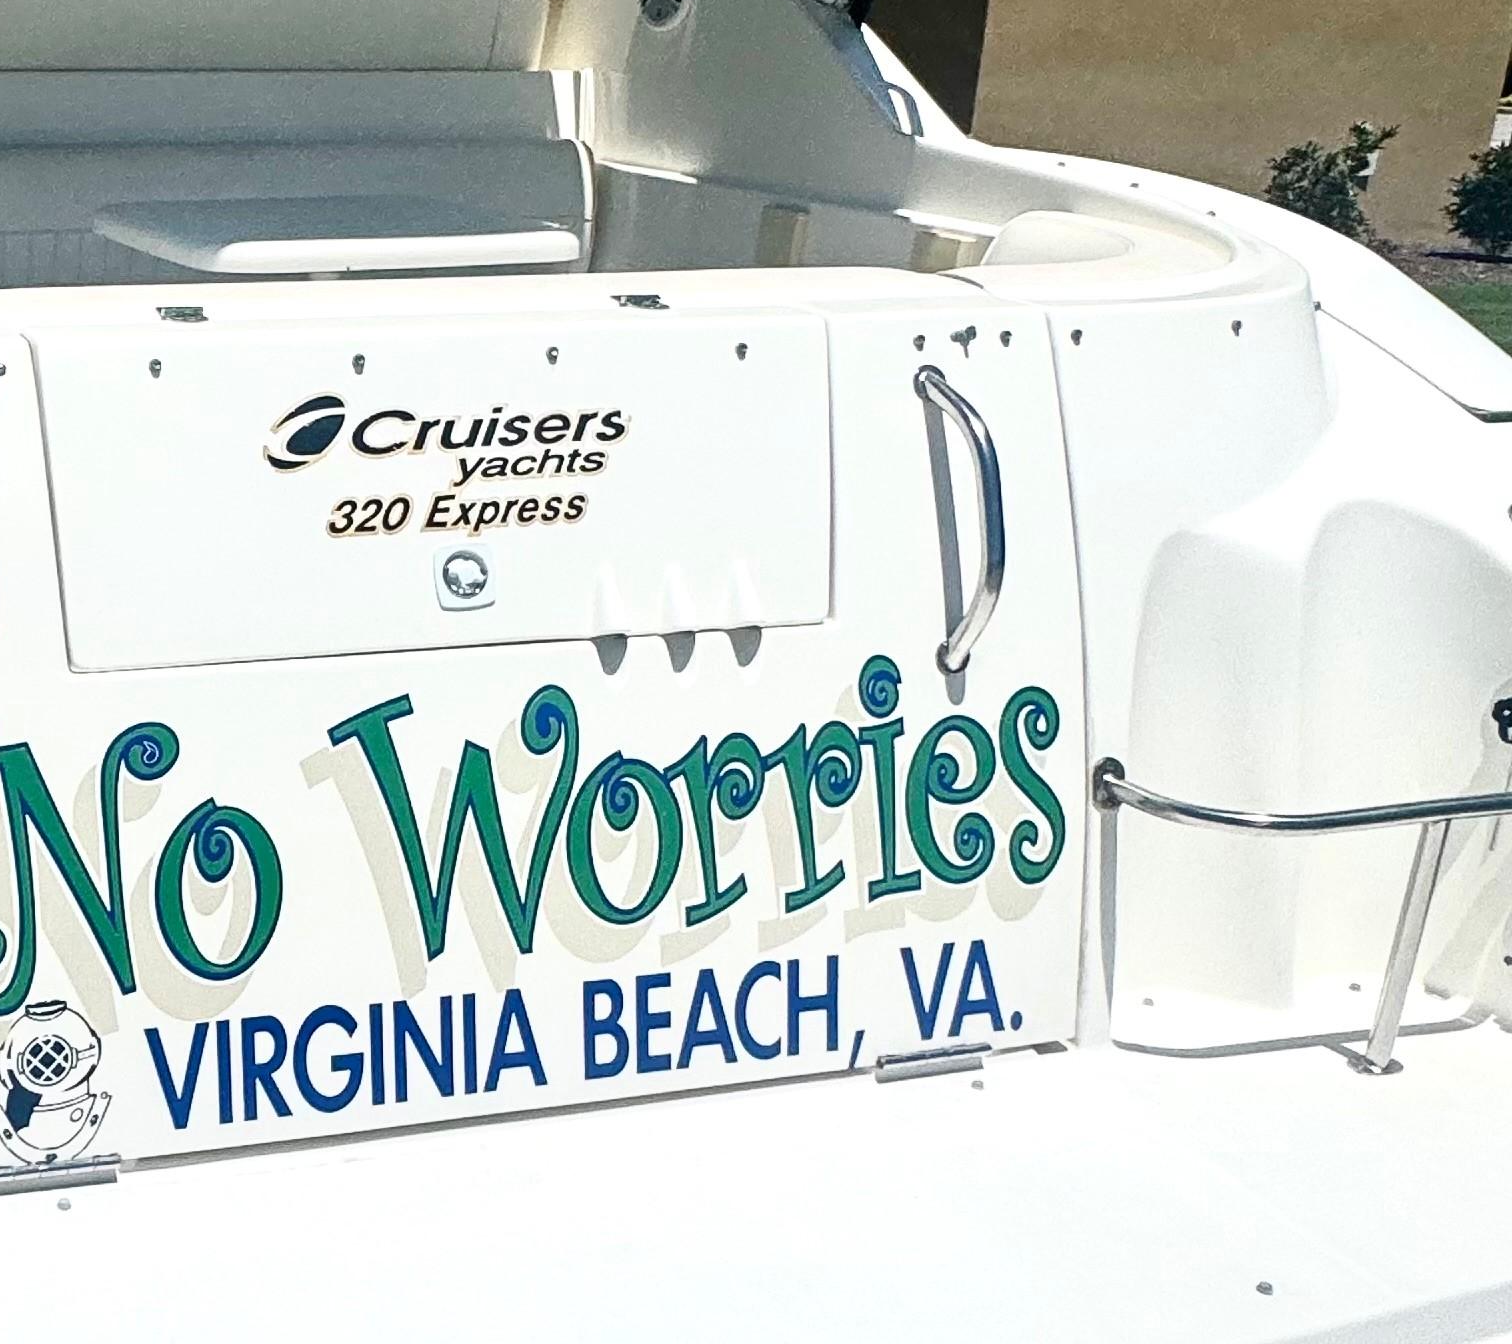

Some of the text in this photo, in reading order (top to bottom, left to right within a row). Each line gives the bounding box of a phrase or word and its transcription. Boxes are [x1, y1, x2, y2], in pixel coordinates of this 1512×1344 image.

[351, 406, 628, 454] Cruisers
[454, 449, 607, 487] yachts
[328, 493, 587, 534] 320 Express
[328, 654, 1066, 961] Worries
[143, 939, 1024, 1131] VIRGINIA BEACH, VA.
